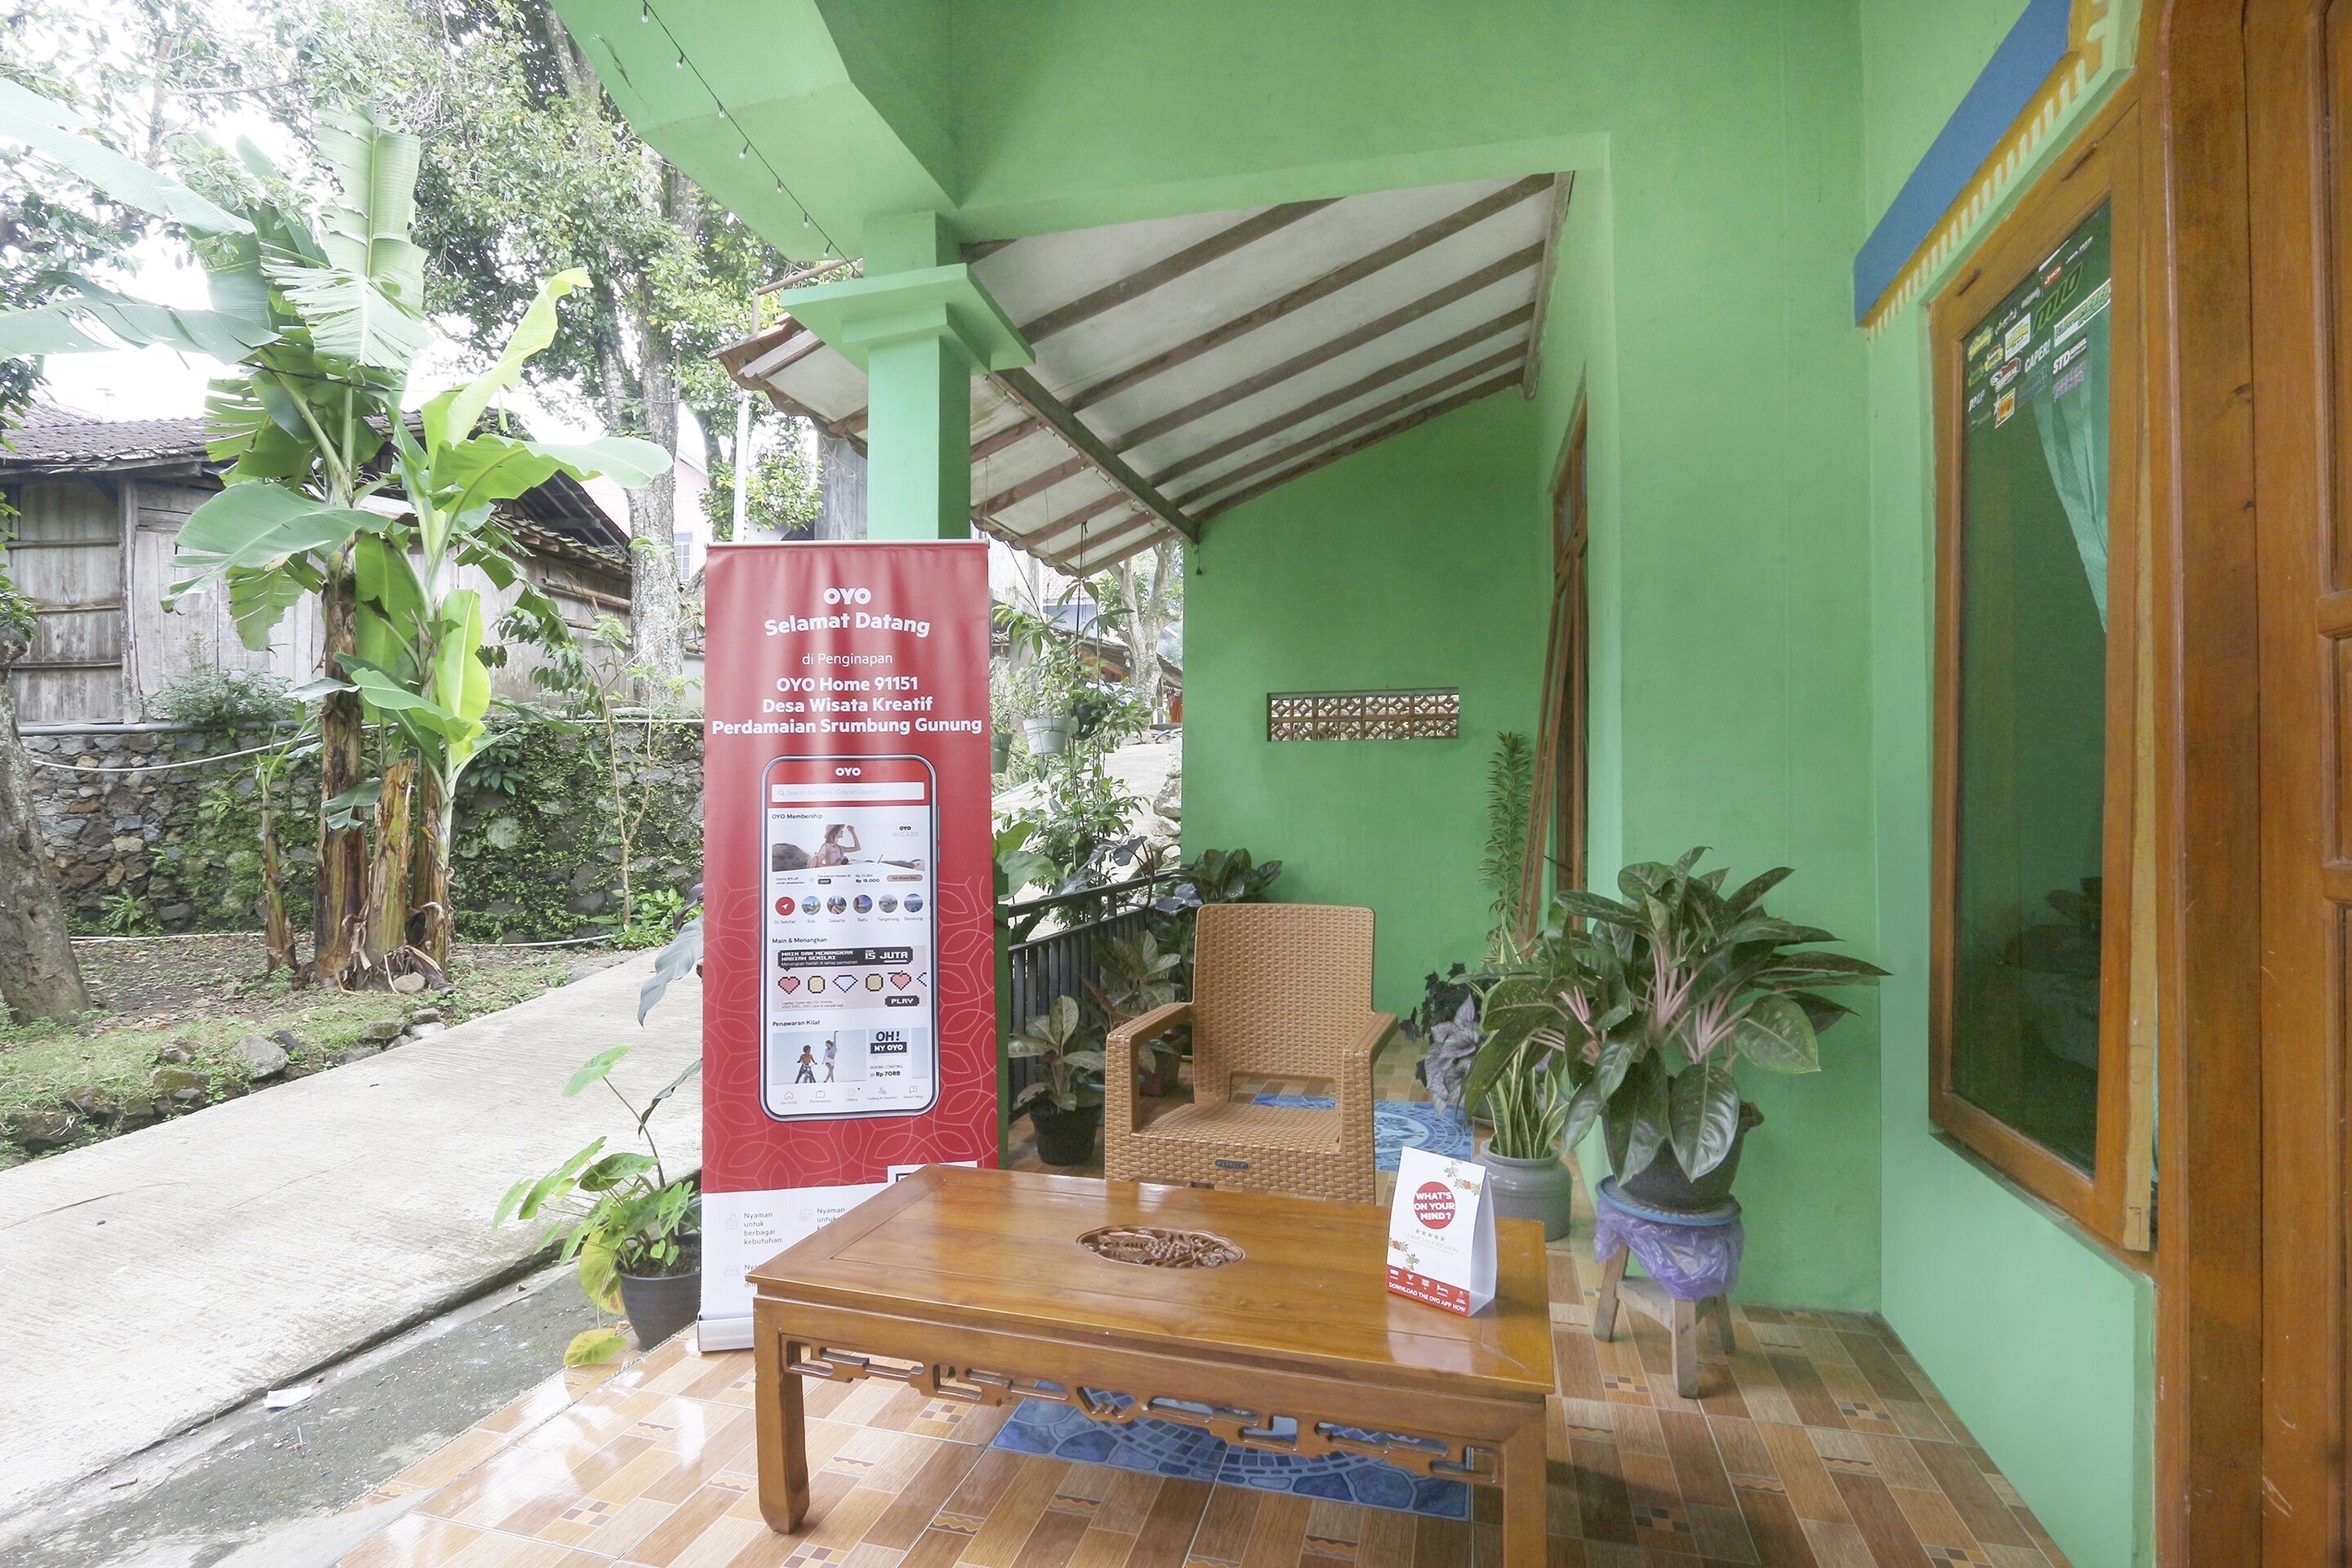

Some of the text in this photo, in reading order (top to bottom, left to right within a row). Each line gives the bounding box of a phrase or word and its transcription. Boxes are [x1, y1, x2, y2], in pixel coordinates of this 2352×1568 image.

[2025, 339, 2051, 372] CAPER!
[2052, 350, 2070, 374] STD
[823, 587, 871, 605] OYO
[764, 612, 931, 638] Selamat Datang
[802, 653, 893, 666] di Penginapan
[777, 676, 919, 693] OYO Home 91151
[763, 696, 933, 714] Desa Wisata Kreatif
[712, 717, 982, 736] Perdamaian Srumbung Gunung
[835, 767, 862, 777] OYO
[875, 1031, 900, 1041] OH!
[1416, 1192, 1452, 1200] WHAT'S
[1414, 1202, 1455, 1211] ON YOUR
[1420, 1212, 1452, 1221] MIND?
[1388, 1282, 1418, 1296] DOWNLOAD
[1418, 1291, 1429, 1300] THE
[1429, 1295, 1441, 1304] OYO
[1452, 1303, 1466, 1312] NOW
